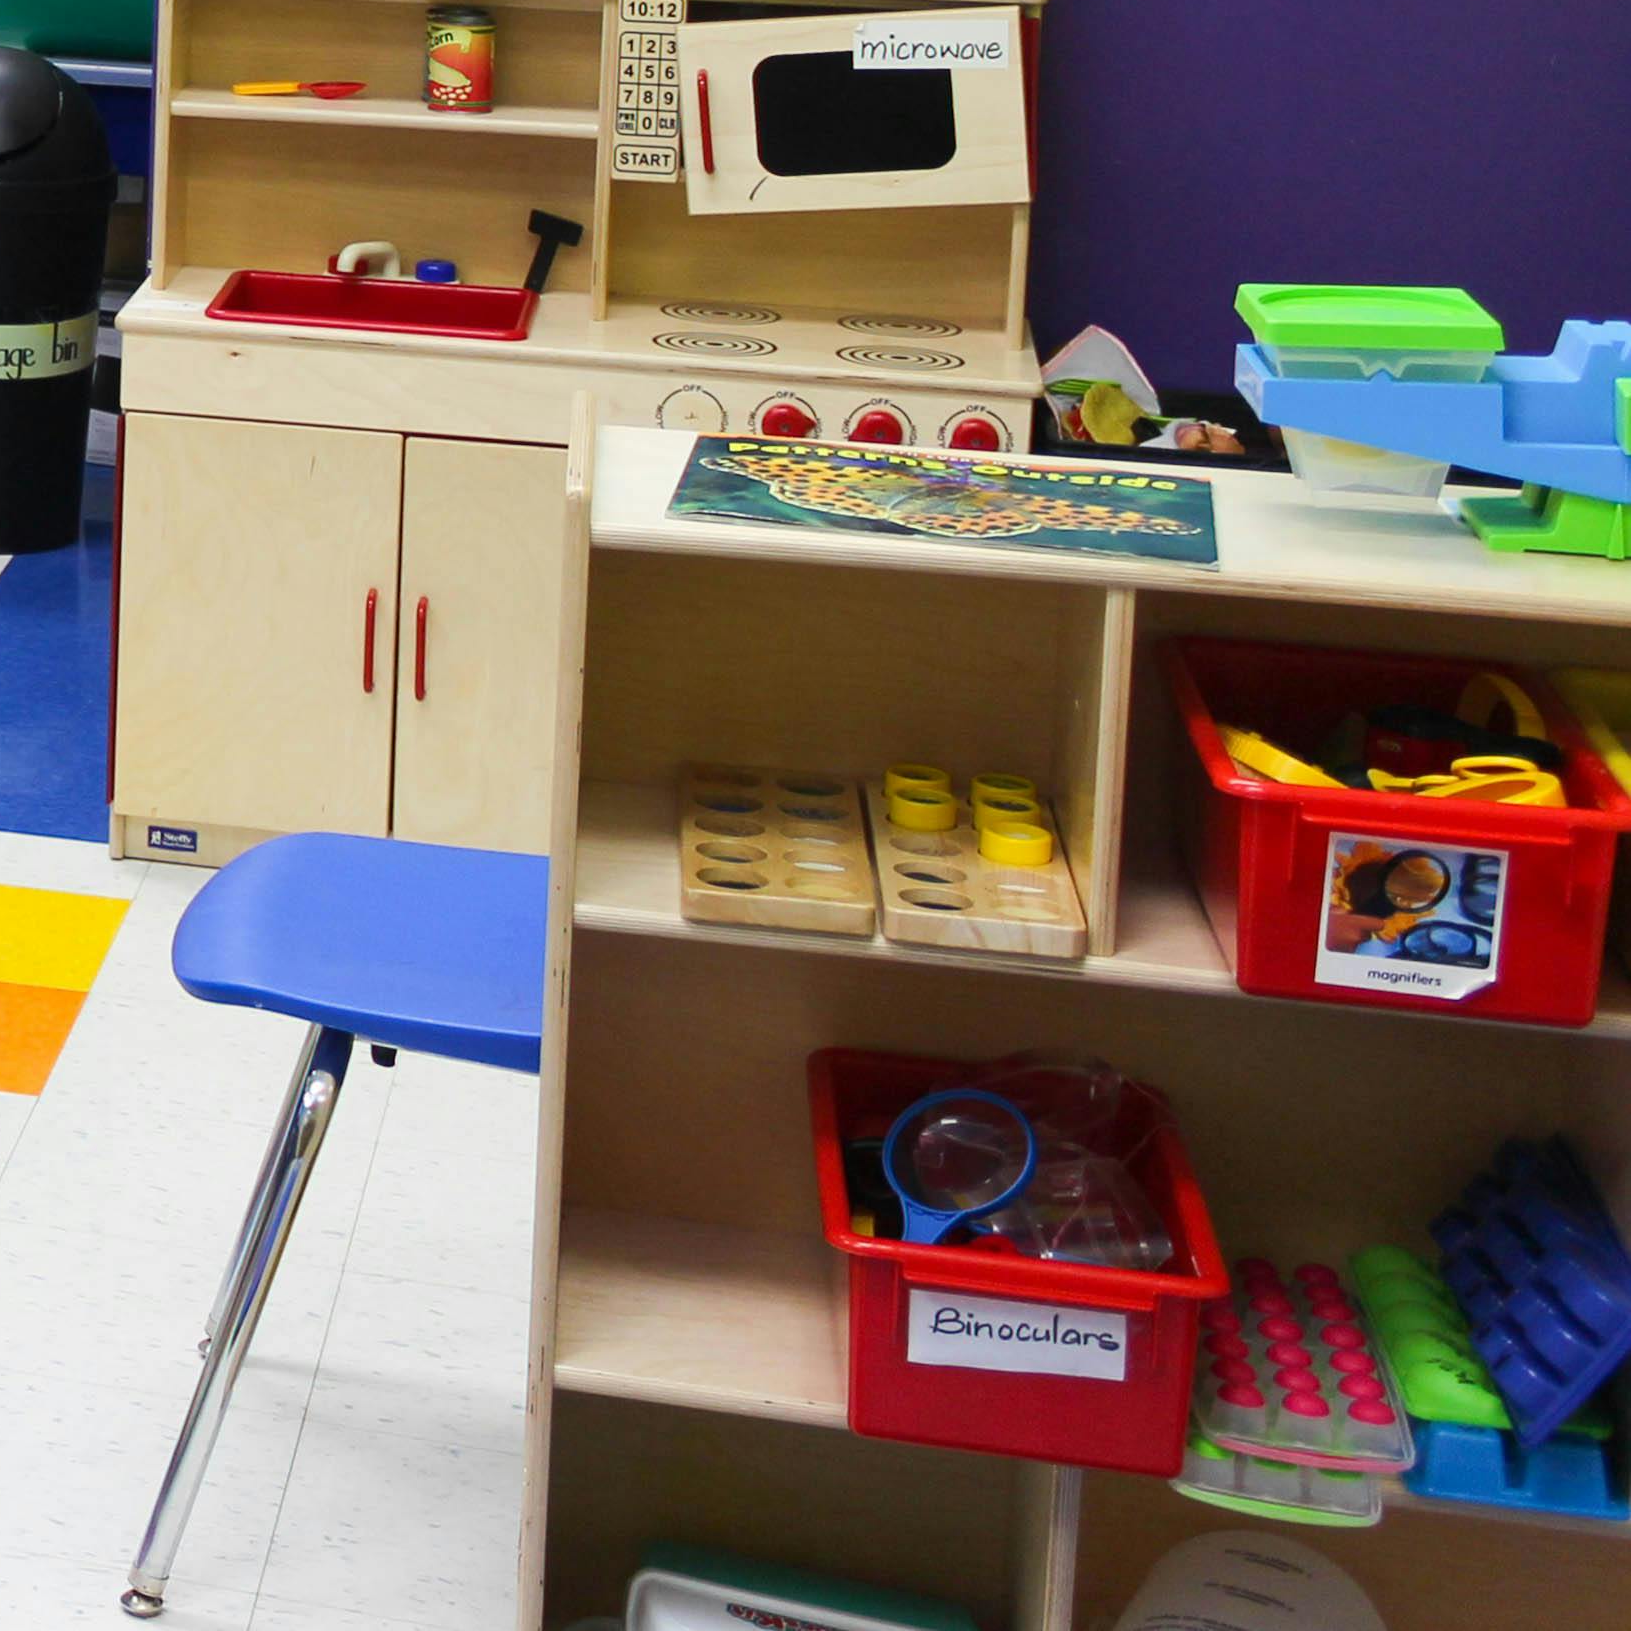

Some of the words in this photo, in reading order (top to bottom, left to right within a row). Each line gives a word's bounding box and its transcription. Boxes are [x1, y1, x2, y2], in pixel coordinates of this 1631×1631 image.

[626, 0, 679, 19] 10:12
[625, 38, 633, 54] 1
[645, 38, 656, 54] 2
[666, 39, 677, 55] 3
[859, 33, 1004, 62] microwave
[623, 63, 634, 79] 4
[643, 64, 655, 80] 5
[664, 65, 675, 80] 6
[623, 89, 633, 105] 7
[642, 90, 654, 105] 8
[662, 90, 674, 106] 9
[618, 111, 636, 122] PWR
[641, 116, 653, 131] 0
[658, 116, 679, 131] CLR
[618, 151, 672, 168] START
[51, 322, 79, 365] bin
[682, 384, 703, 392] OFF
[776, 391, 796, 399] OFF
[870, 398, 890, 406] OFF
[965, 405, 987, 413] OFF
[727, 440, 948, 471] Patterns
[970, 464, 1180, 491] Outside
[1367, 968, 1442, 987] magnifiers
[929, 1306, 1121, 1352] Binoculars
